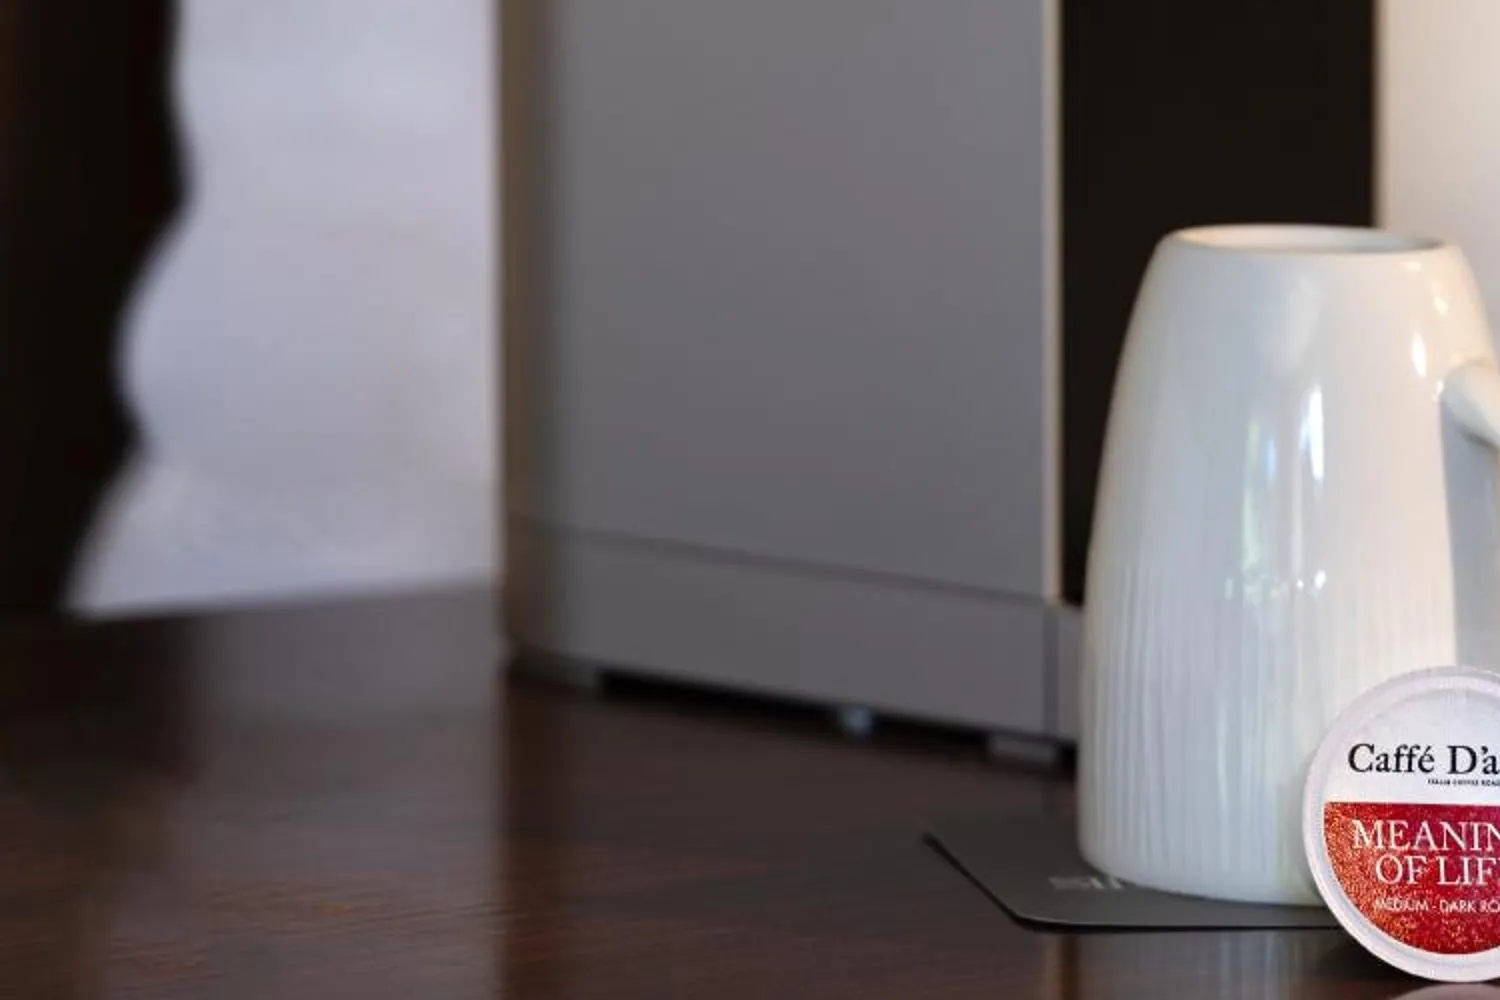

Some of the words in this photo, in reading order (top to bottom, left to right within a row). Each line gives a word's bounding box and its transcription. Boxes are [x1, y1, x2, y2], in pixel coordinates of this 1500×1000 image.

[1348, 743, 1435, 774] Caffé
[1375, 853, 1427, 884] OF
[1374, 898, 1429, 912] MEDIUM
[1440, 899, 1477, 913] DARK
